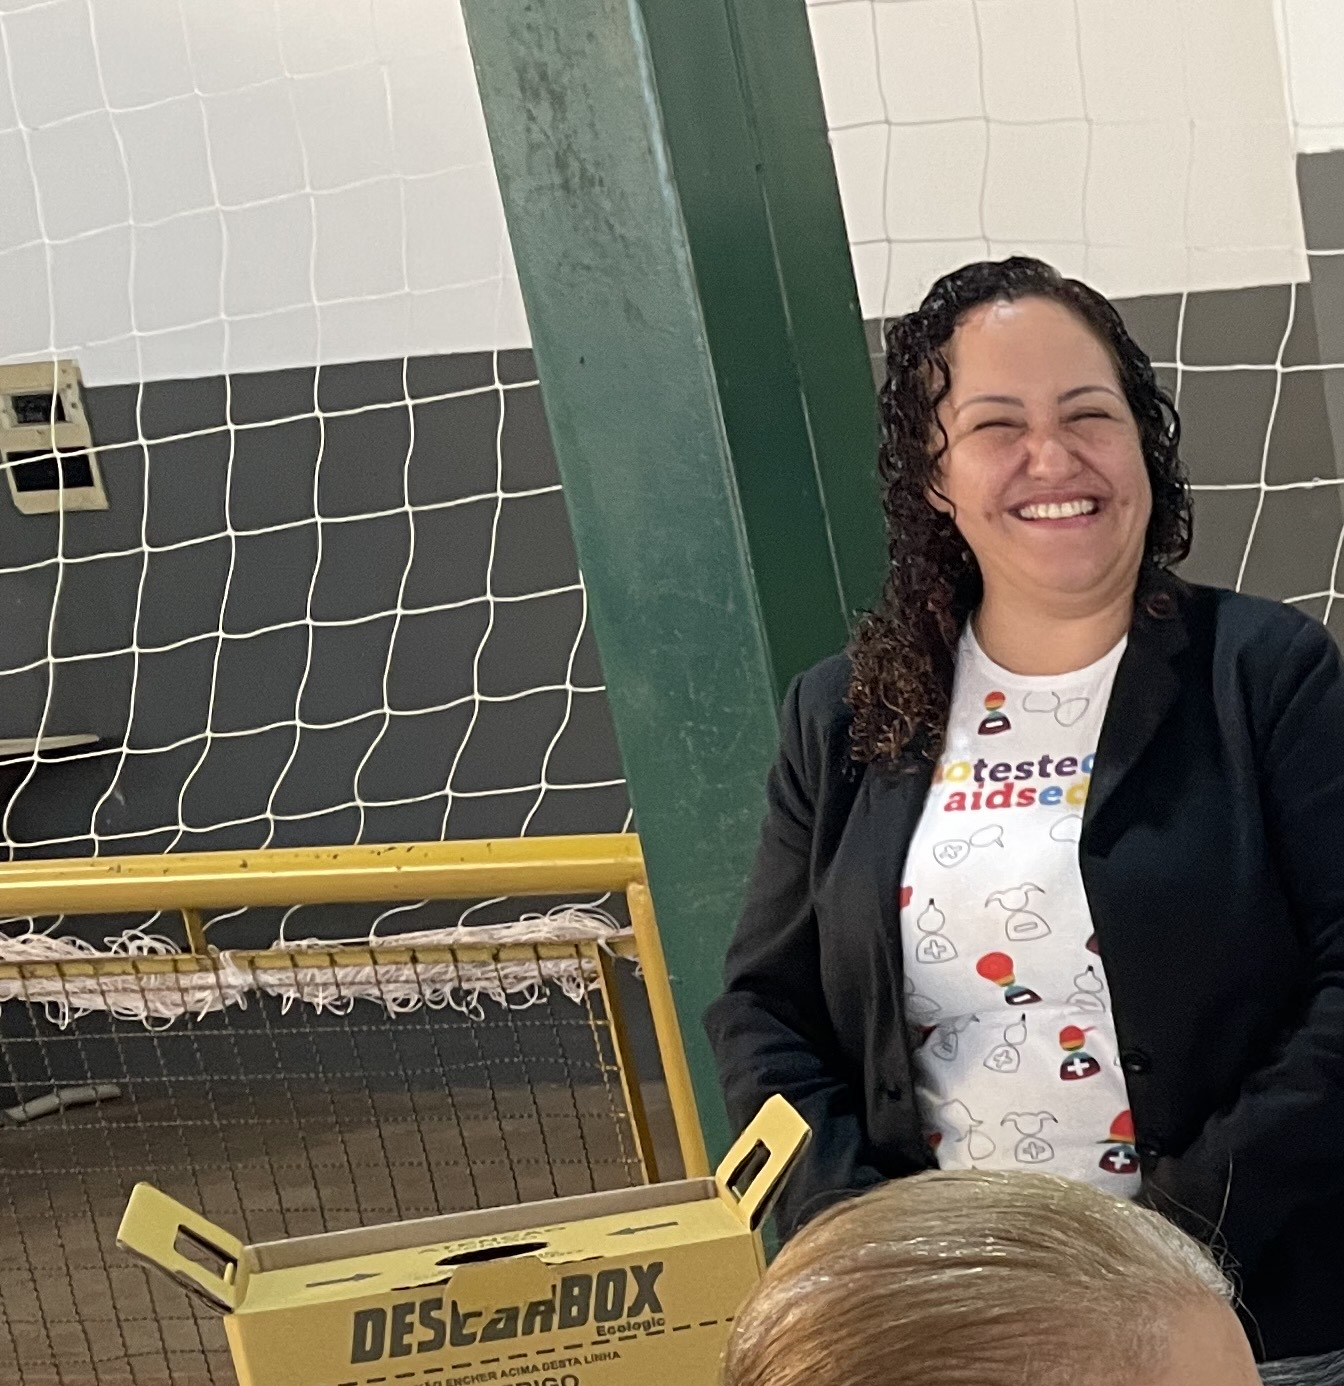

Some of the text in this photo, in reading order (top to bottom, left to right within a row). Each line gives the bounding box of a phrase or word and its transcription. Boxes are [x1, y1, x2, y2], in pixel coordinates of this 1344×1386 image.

[446, 1369, 498, 1386] ENCHER
[500, 1363, 541, 1380] ACIMA
[542, 1357, 582, 1373] DESTA
[584, 1350, 621, 1367] LINHA
